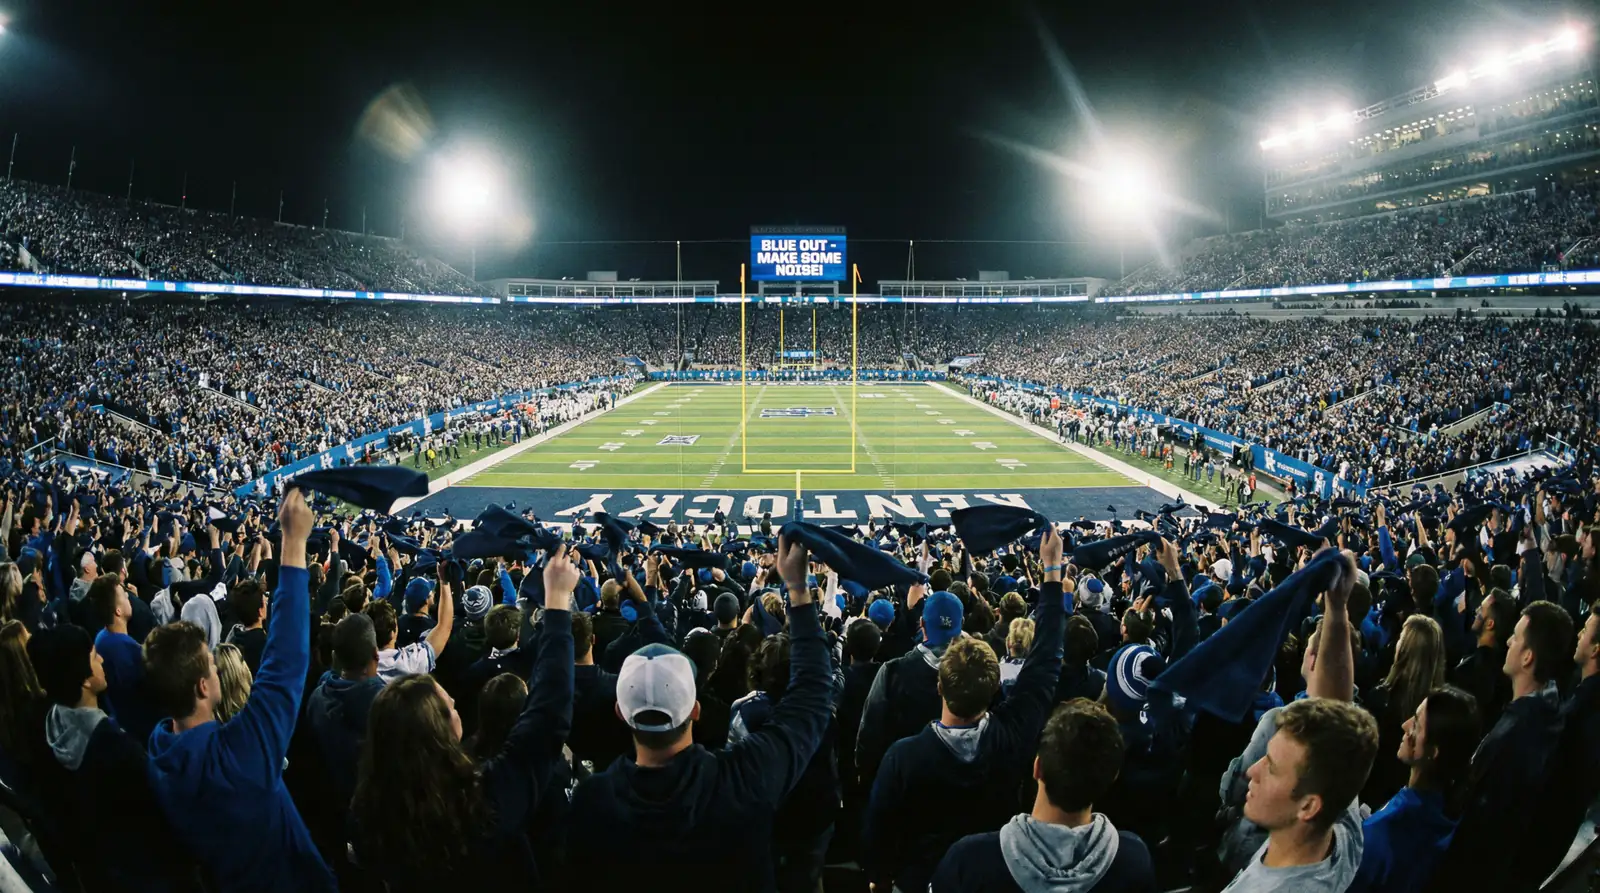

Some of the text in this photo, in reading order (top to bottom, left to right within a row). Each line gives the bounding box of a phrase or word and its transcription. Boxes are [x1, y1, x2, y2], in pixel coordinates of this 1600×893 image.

[761, 239, 797, 252] BLUE
[799, 239, 828, 252] OUT
[757, 251, 842, 264] MAKE SOME
